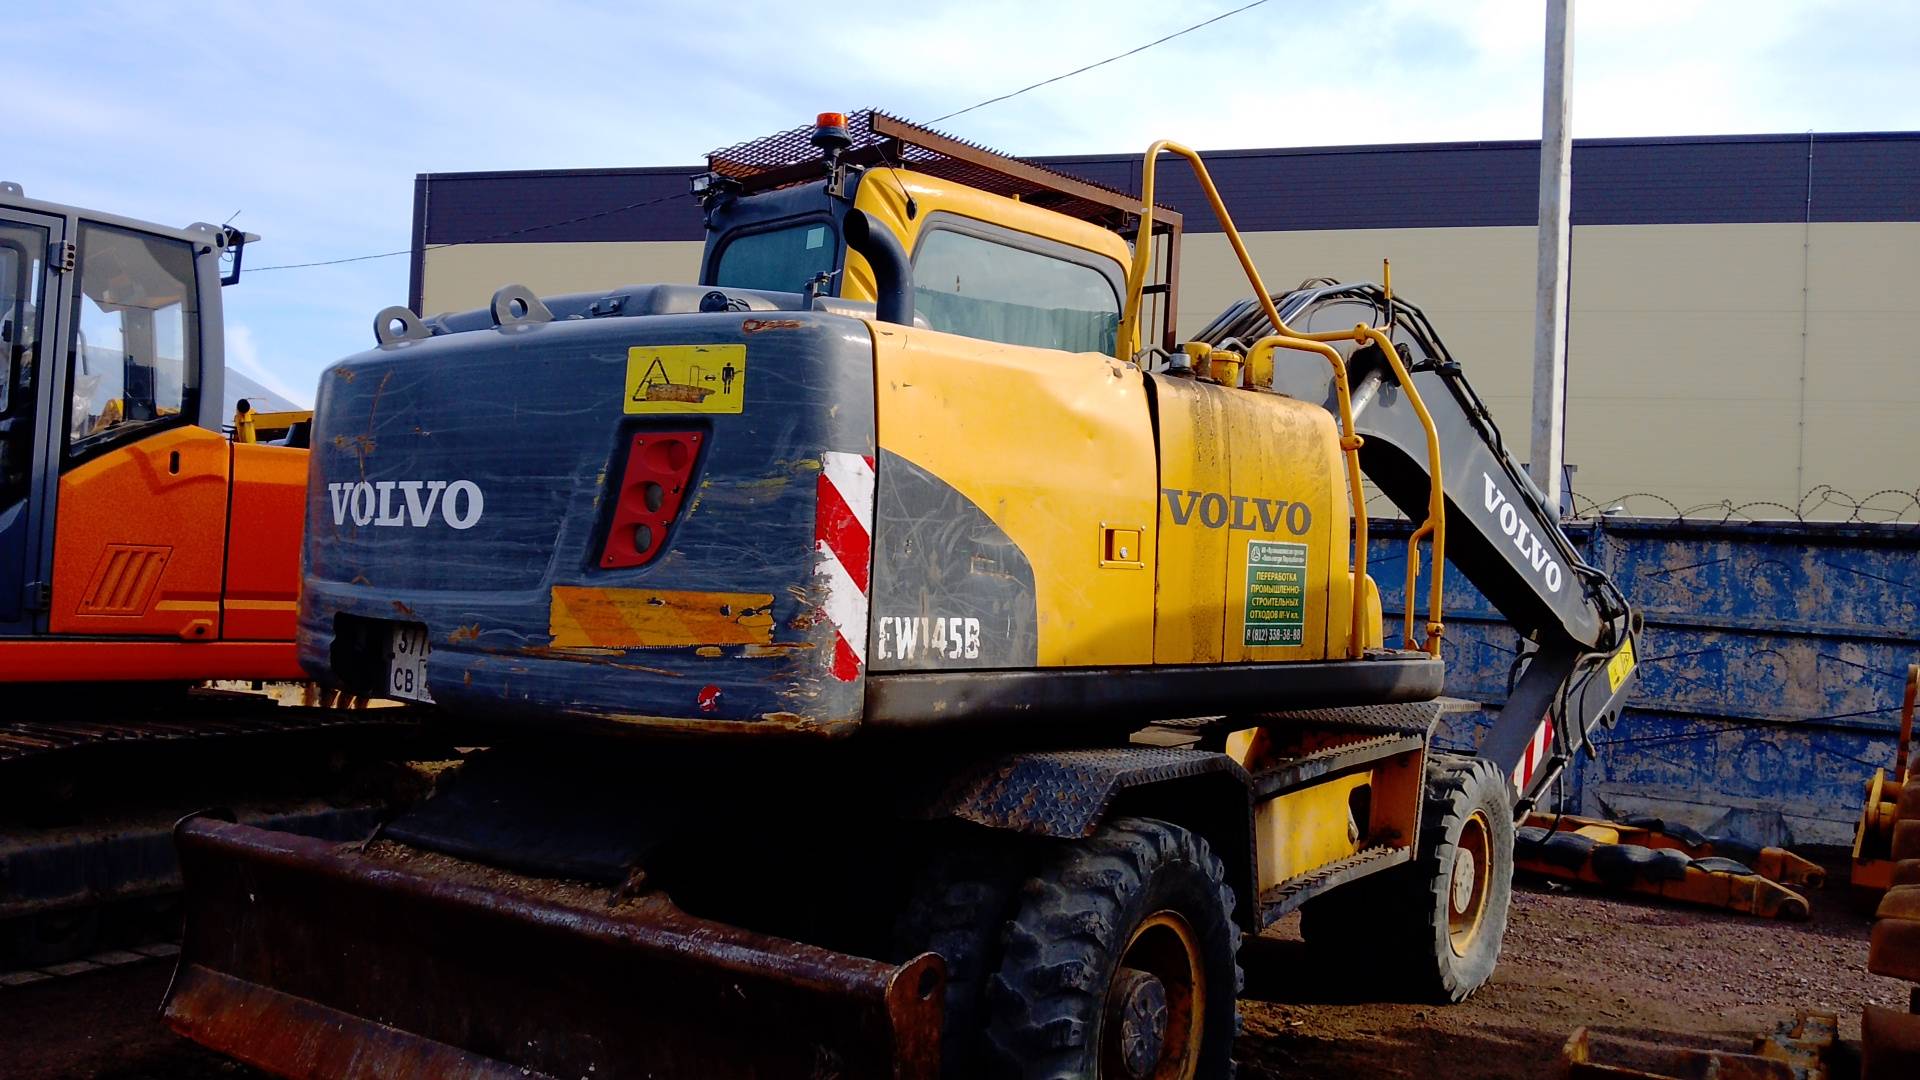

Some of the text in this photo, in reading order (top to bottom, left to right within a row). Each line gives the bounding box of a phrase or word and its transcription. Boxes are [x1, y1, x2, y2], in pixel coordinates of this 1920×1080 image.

[328, 479, 484, 530] VOLVO
[1161, 488, 1312, 536] VOLVO
[1483, 472, 1561, 593] VOLVO
[1256, 571, 1297, 581] ПЕРЕРАБОТКА
[1249, 610, 1278, 620] ОТХОДОВ
[1251, 597, 1299, 607] СТРОИТЕЛЬНЫХ
[878, 616, 980, 660] EW145B
[1251, 627, 1268, 642] (812)
